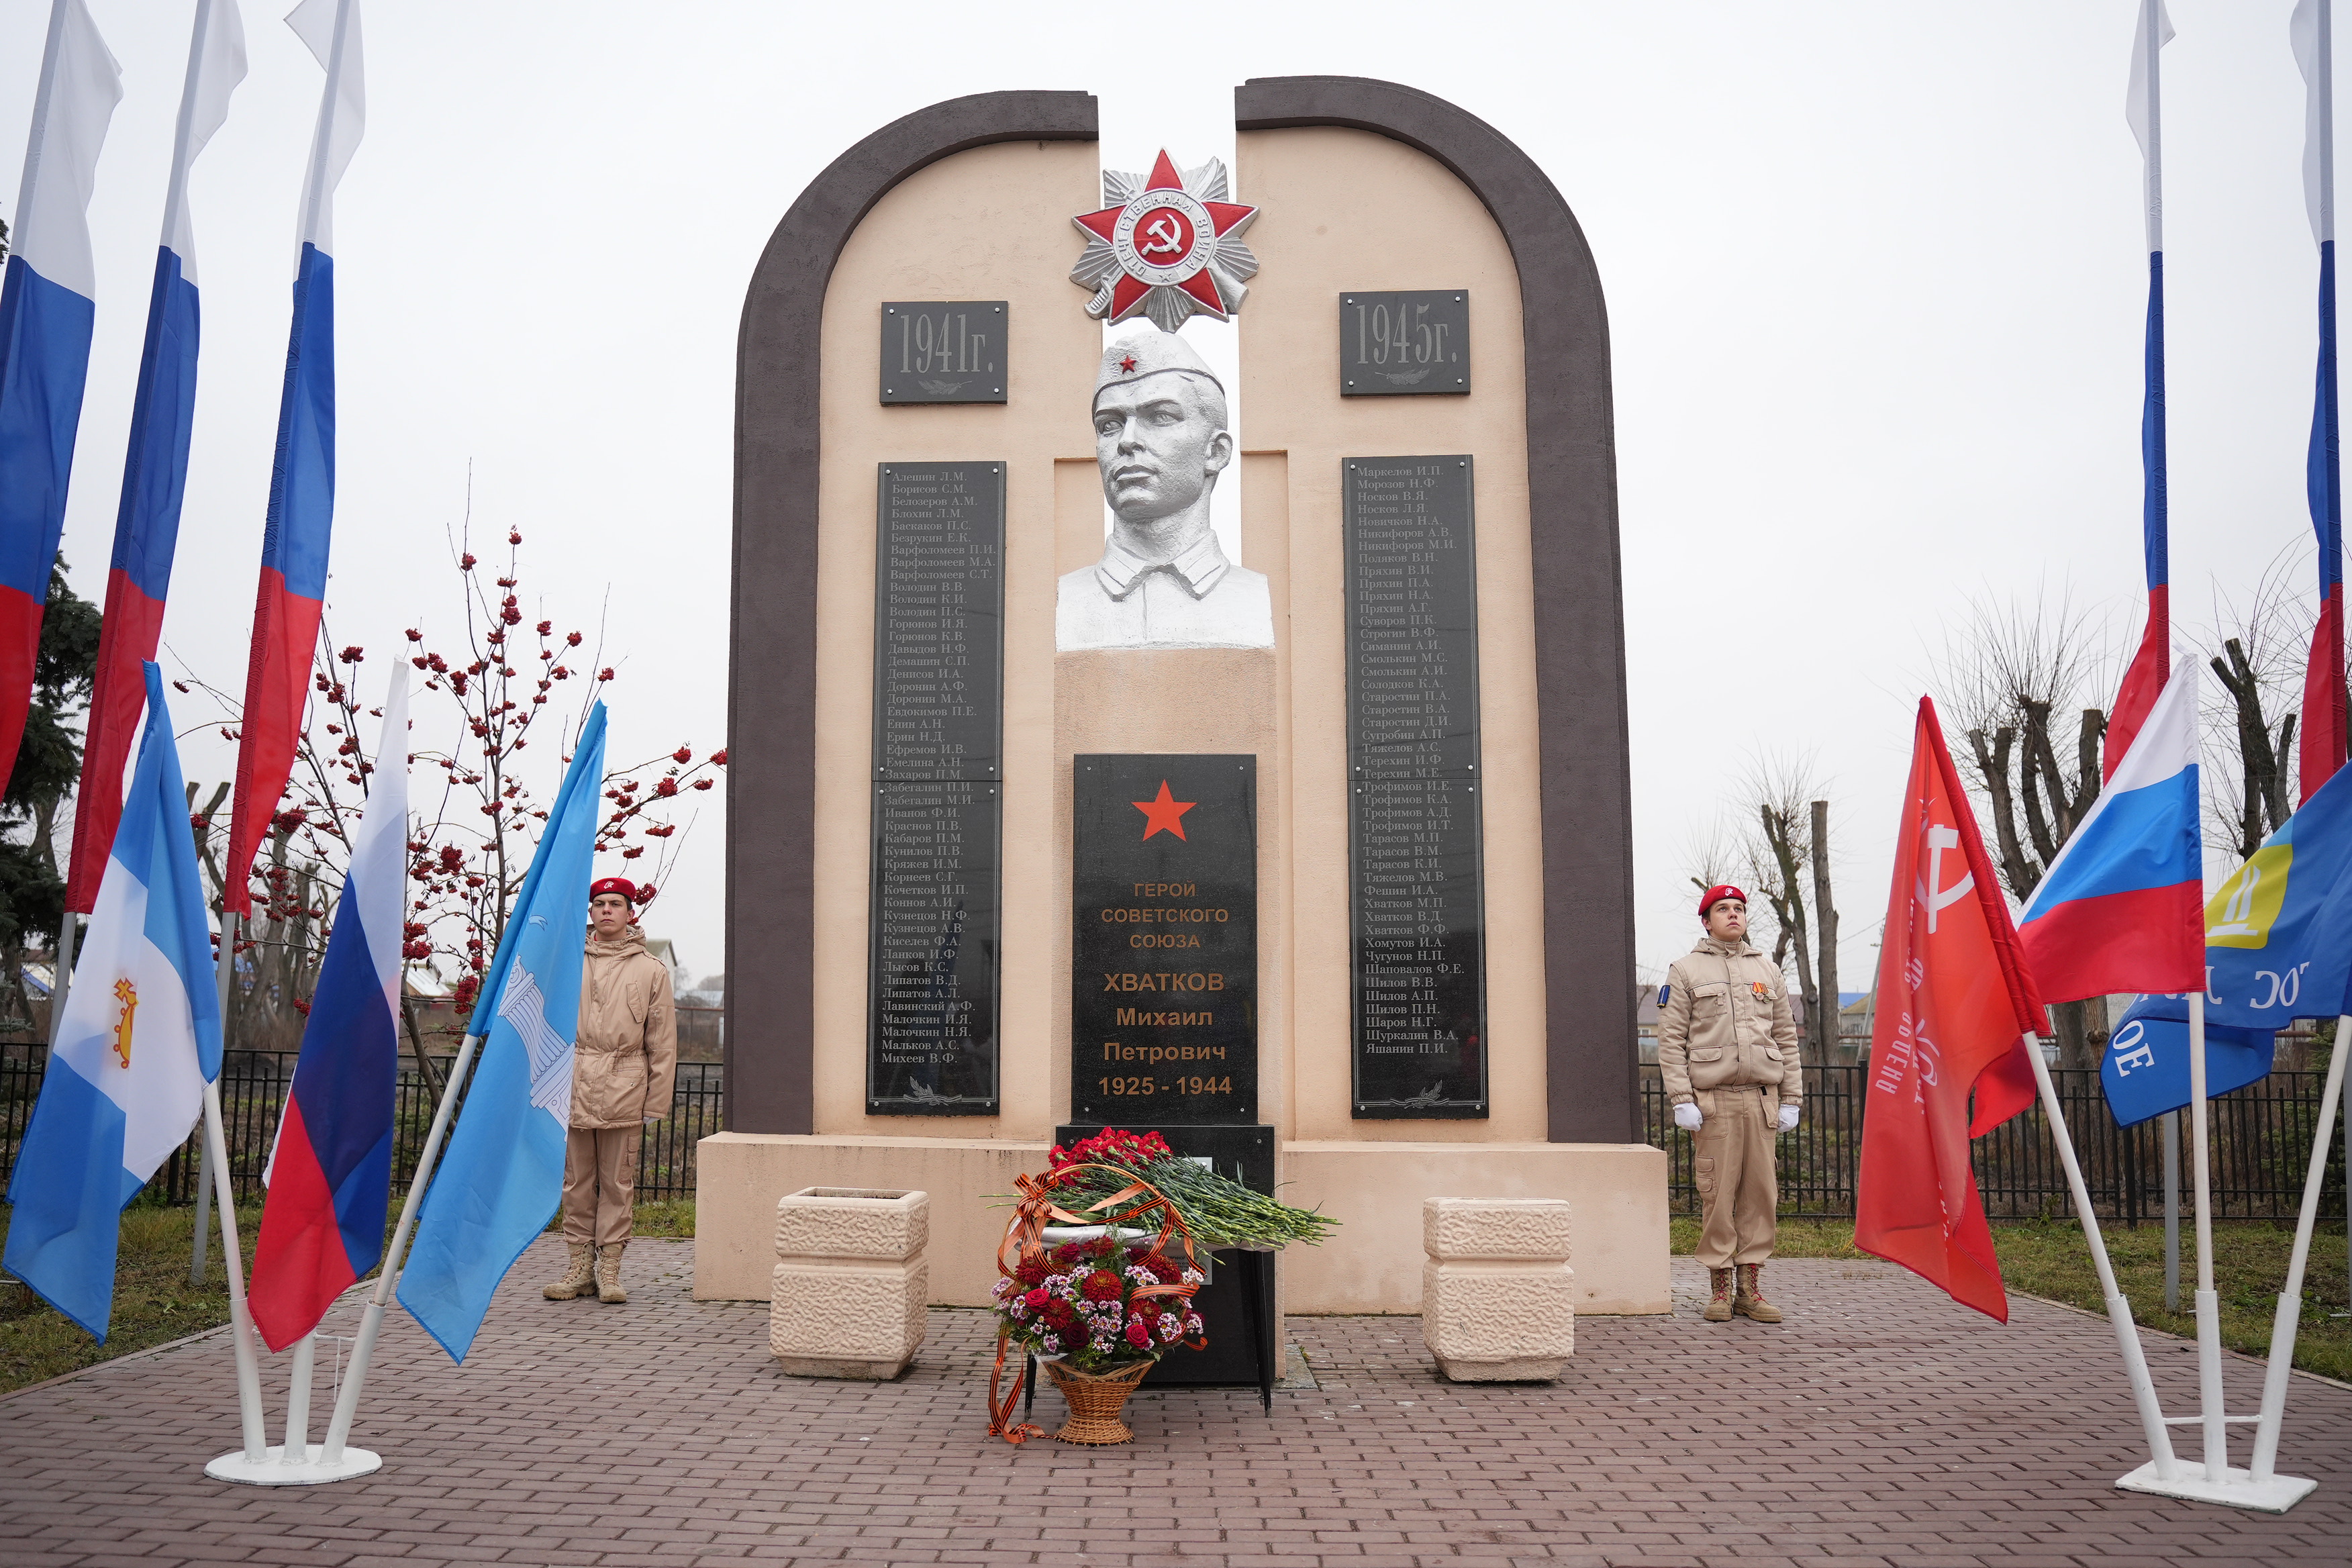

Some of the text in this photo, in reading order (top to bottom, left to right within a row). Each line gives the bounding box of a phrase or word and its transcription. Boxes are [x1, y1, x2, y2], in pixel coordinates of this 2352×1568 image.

[1118, 192, 1194, 276] ОТЕЧЕСТВЕННАЯ
[1356, 303, 1457, 364] 1945г.
[900, 313, 993, 373] 1941г.
[892, 472, 967, 481] Алешин Л.М.
[1357, 466, 1444, 479] Маркелов И.П.
[1357, 491, 1428, 501] Носков В.Я.
[892, 497, 978, 507] Белозеров А.М.
[891, 509, 964, 518] Блохин Л.М.
[1358, 503, 1428, 513] Носков Л.Я.
[1358, 516, 1442, 526] Новичков Н.А.
[891, 533, 971, 544] Безрукин Е.К.
[891, 545, 996, 556] Варфоломеев П.И.
[1359, 540, 1457, 552] Никифоров М.И.
[1359, 552, 1438, 562] Поляков В.Н.
[890, 570, 992, 581] Варфоломеев С.Т.
[890, 582, 966, 592] Володин В.В.
[1359, 578, 1433, 591] Пряхин П.А.
[889, 607, 966, 617] Володин П.С.
[1360, 603, 1431, 616] Пряхин А.Г.
[889, 619, 968, 630] Горюнов И.Я.
[1360, 615, 1437, 628] Суворов П.К.
[889, 644, 969, 655] Давыдов Н.Ф.
[1361, 640, 1442, 650] Симанин А.И.
[888, 656, 970, 667] Демашин С.П.
[1361, 652, 1448, 663] Смолькин М.С.
[888, 681, 968, 693] Доронин А.Ф.
[1361, 679, 1444, 689] Солодков К.А.
[887, 694, 967, 705] Доронин М.А.
[1361, 691, 1451, 703] Старостин П.А.
[887, 719, 945, 728] Енин А.Н.
[1362, 716, 1452, 729] Старостин Д.И.
[887, 732, 945, 744] Ерин Н.Д.
[1362, 729, 1446, 742] Сугробин А.П.
[887, 757, 964, 767] Емелина А.Н.
[1362, 754, 1444, 768] Терехин И.Ф.
[885, 769, 964, 781] Захаров П.М.
[1362, 768, 1442, 779] Терехин М.Е.
[884, 782, 974, 792] Забегалин П.И.
[1362, 781, 1453, 793] Трофимов И.Е.
[885, 807, 961, 817] Иванов Ф.И.
[1362, 807, 1452, 820] Трофимов А.Д.
[885, 821, 962, 832] Краснов П.В.
[1362, 820, 1453, 832] Трофимов И.Т.
[885, 833, 965, 845] Кабаров П.М.
[1363, 846, 1442, 859] Тарасов В.М.
[884, 859, 962, 871] Кряжев И.М.
[1363, 859, 1442, 871] Тарасов К.И.
[884, 872, 958, 884] Корнеев С.Г.
[884, 885, 969, 894] Кочетков И.П.
[1134, 880, 1196, 897] ГЕРОЙ
[1364, 885, 1438, 895] Фешин И.А.
[1364, 897, 1447, 908] Хватков М.П.
[884, 910, 971, 922] Кузнецов Н.Ф.
[1101, 909, 1229, 923] СОВЕТСКОГО
[1364, 911, 1443, 922] Хватков В.Д.
[883, 923, 965, 935] Кузнецов А.В.
[1129, 934, 1201, 948] СОЮЗА
[1365, 938, 1446, 950] Хомутов И.А.
[882, 949, 959, 959] Ланков И.Ф.
[1366, 950, 1445, 963] Чугунов Н.П.
[883, 962, 948, 971] Лысов К.С.
[1365, 963, 1465, 973] Шаповалов Ф.Е.
[883, 975, 961, 986] Липатов В.Д.
[1104, 973, 1225, 991] ХВАТКОВ
[1365, 977, 1437, 987] Шилов В.В.
[1365, 991, 1438, 1000] Шилов А.П.
[882, 1001, 975, 1010] Лавинский А.Ф.
[882, 1014, 972, 1024] Малочкин И.Я.
[1116, 1008, 1213, 1026] Михаил
[1366, 1017, 1437, 1029] Шаров Н.Г.
[882, 1027, 971, 1036] Малочкин Н.Я.
[1366, 1030, 1459, 1042] Шуркалин В.А.
[881, 1040, 959, 1049] Мальков А.С.
[1365, 1043, 1448, 1053] Яшанин П.И.
[881, 1053, 957, 1063] Михеев В.Ф.
[1104, 1042, 1226, 1065] Петрович
[1099, 1077, 1155, 1095] 1925
[1176, 1076, 1232, 1094] 1944
